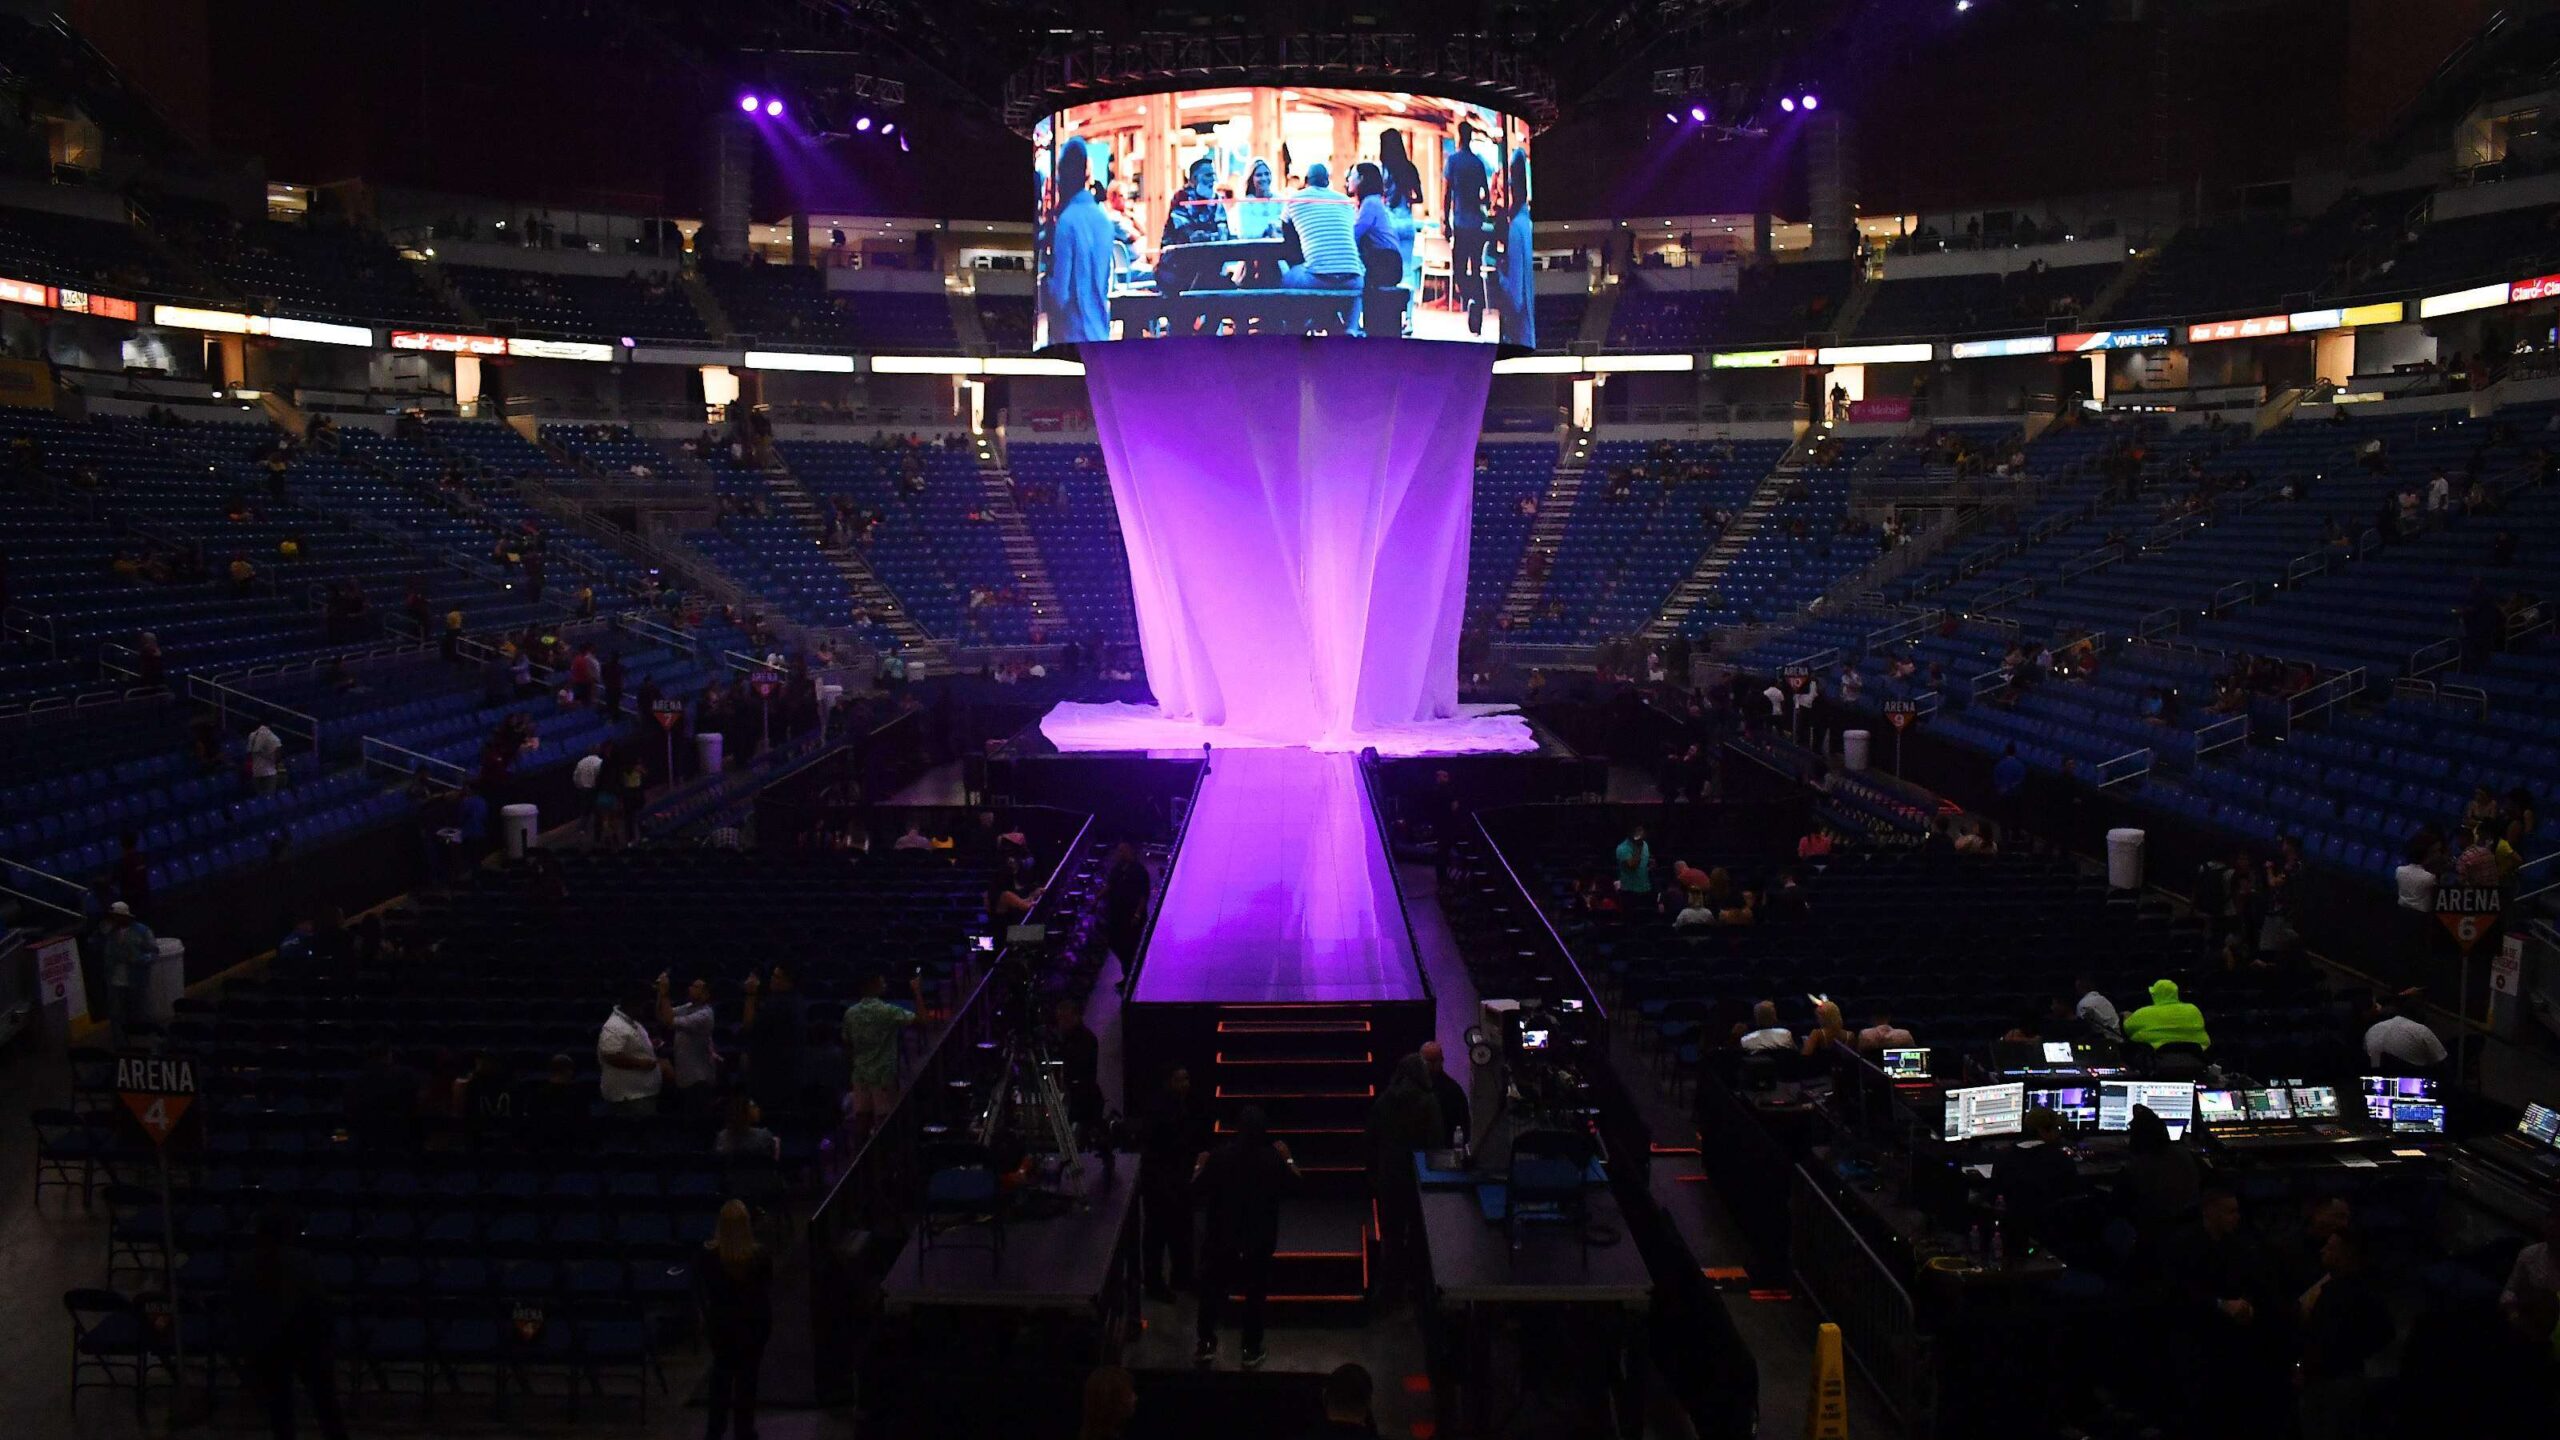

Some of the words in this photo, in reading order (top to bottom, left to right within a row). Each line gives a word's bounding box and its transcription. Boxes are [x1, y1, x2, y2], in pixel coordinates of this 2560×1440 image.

[2511, 284, 2541, 301] Claro
[2543, 281, 2560, 296] Cla
[1884, 701, 1916, 711] ARENA
[2435, 888, 2500, 912] ARENA
[2458, 916, 2477, 940] 6
[117, 1058, 194, 1092] ARENA
[144, 1099, 168, 1130] 4
